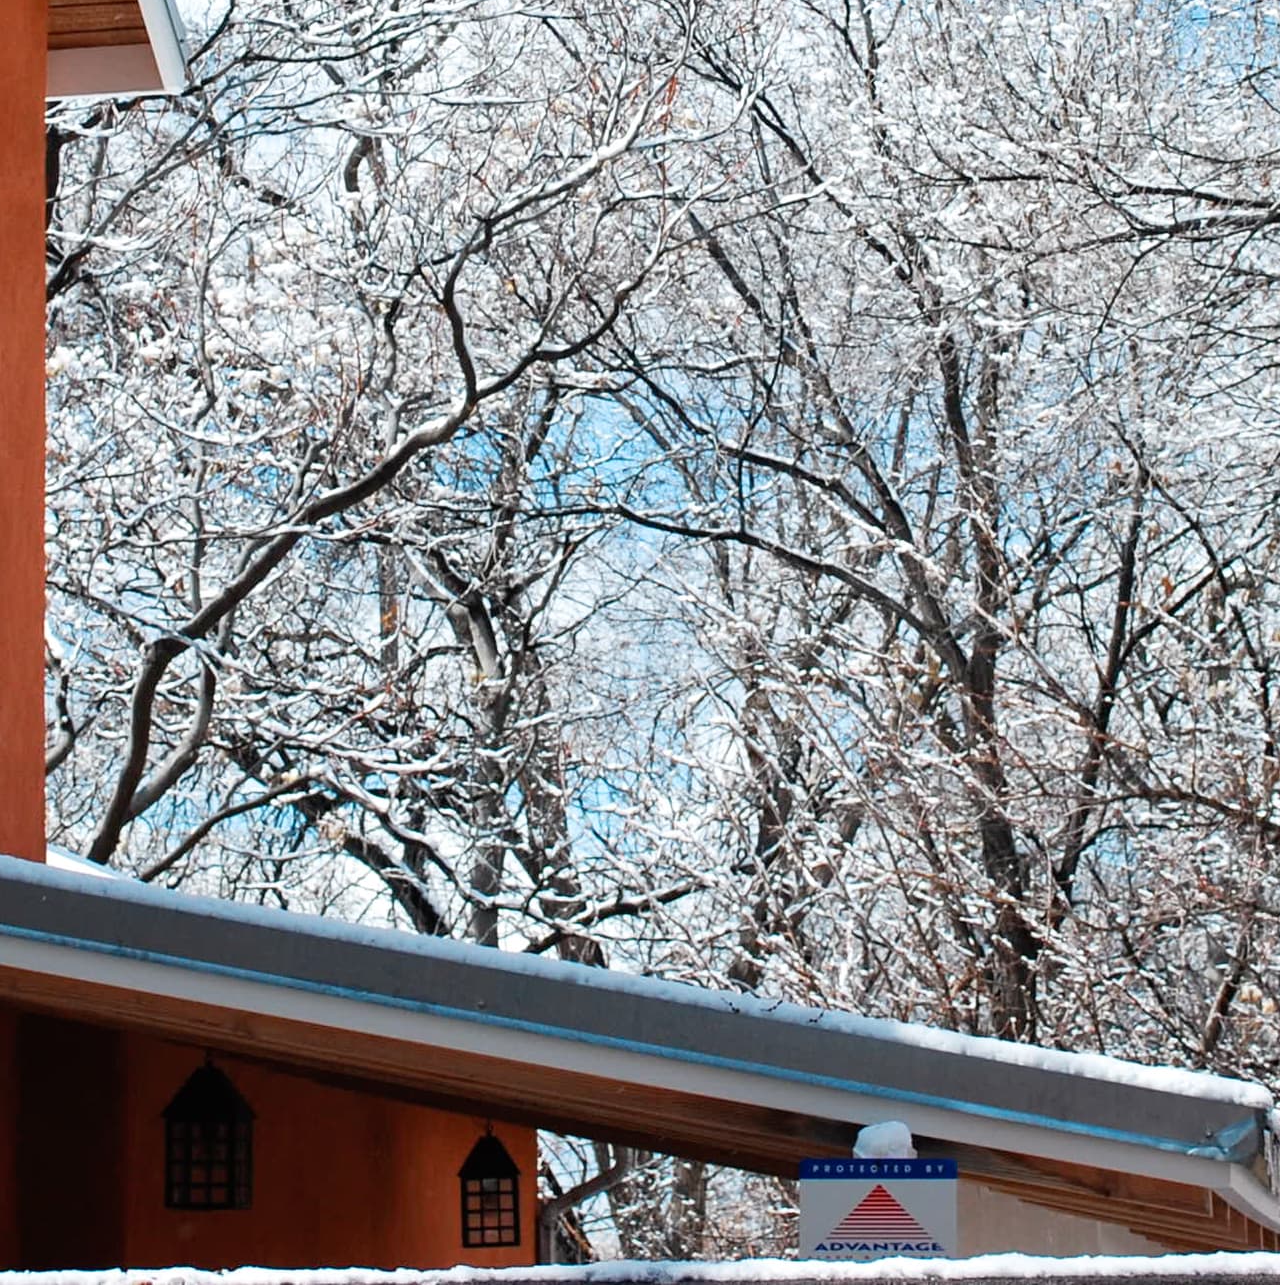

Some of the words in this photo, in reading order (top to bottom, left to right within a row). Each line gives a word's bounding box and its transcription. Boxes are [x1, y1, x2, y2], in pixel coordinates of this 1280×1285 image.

[812, 1165, 912, 1173] PROTECTED
[926, 1165, 944, 1173] BY
[814, 1242, 945, 1251] ADVANTAGE
